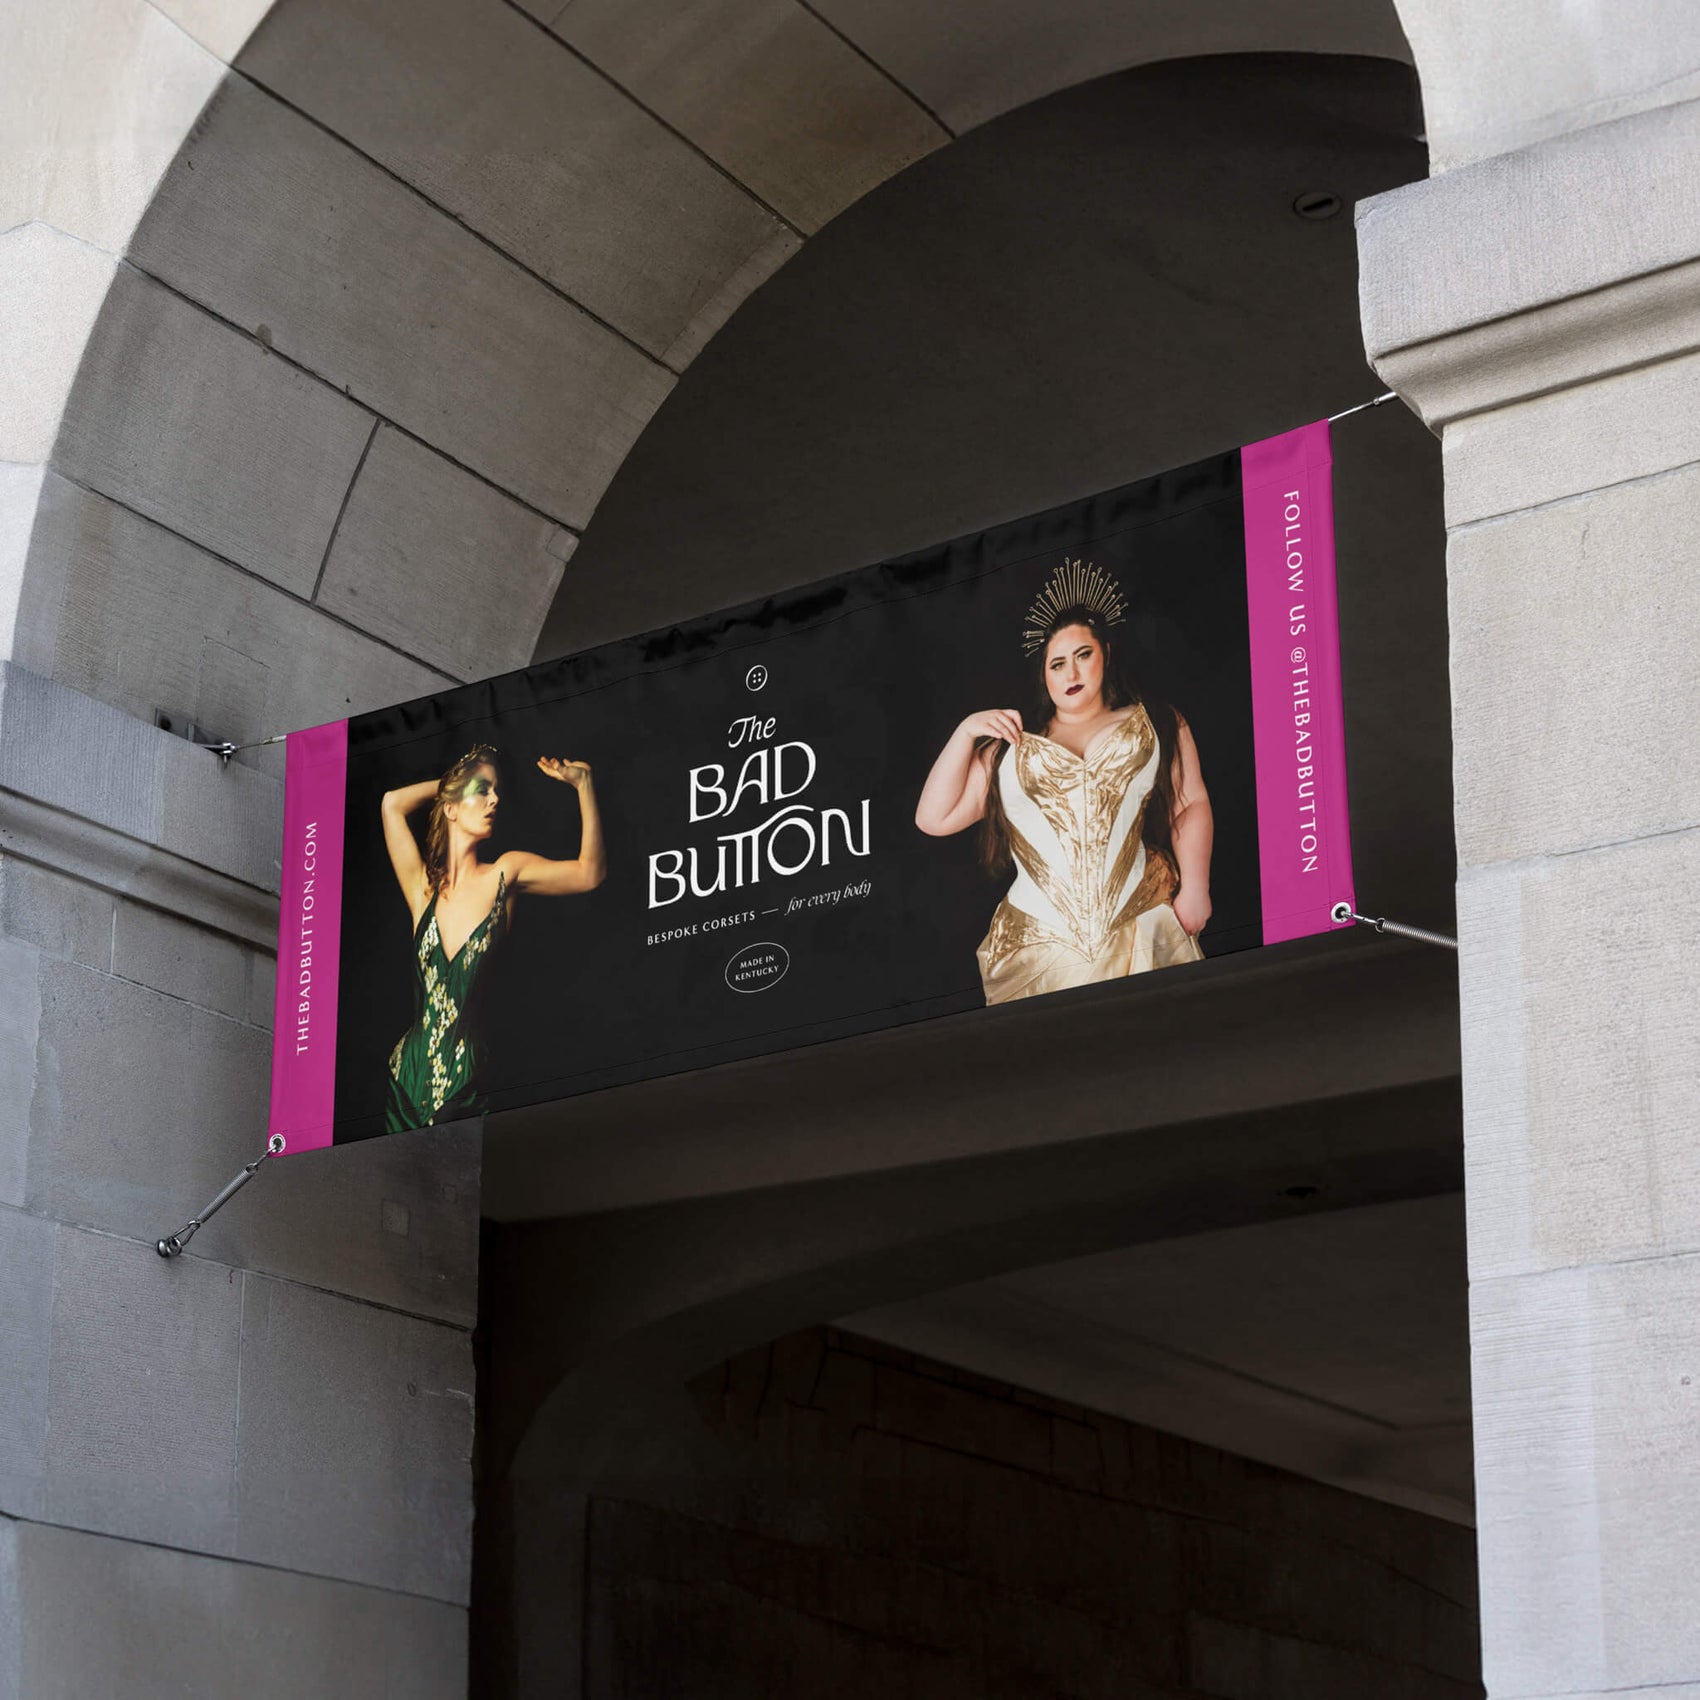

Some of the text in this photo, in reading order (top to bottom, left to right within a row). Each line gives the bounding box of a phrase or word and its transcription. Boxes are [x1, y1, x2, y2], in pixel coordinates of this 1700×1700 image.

[1283, 490, 1318, 873] FOLLOW US @THEBADBUTTON
[728, 715, 776, 748] The
[689, 741, 816, 823] BAD
[648, 799, 871, 909] BUTTON
[296, 822, 317, 1056] THEBADBUTTON.COM
[647, 879, 872, 946] BESPOKE CORSETS for every body
[735, 965, 780, 982] KENTUCKY
[739, 954, 775, 969] MADE IN
